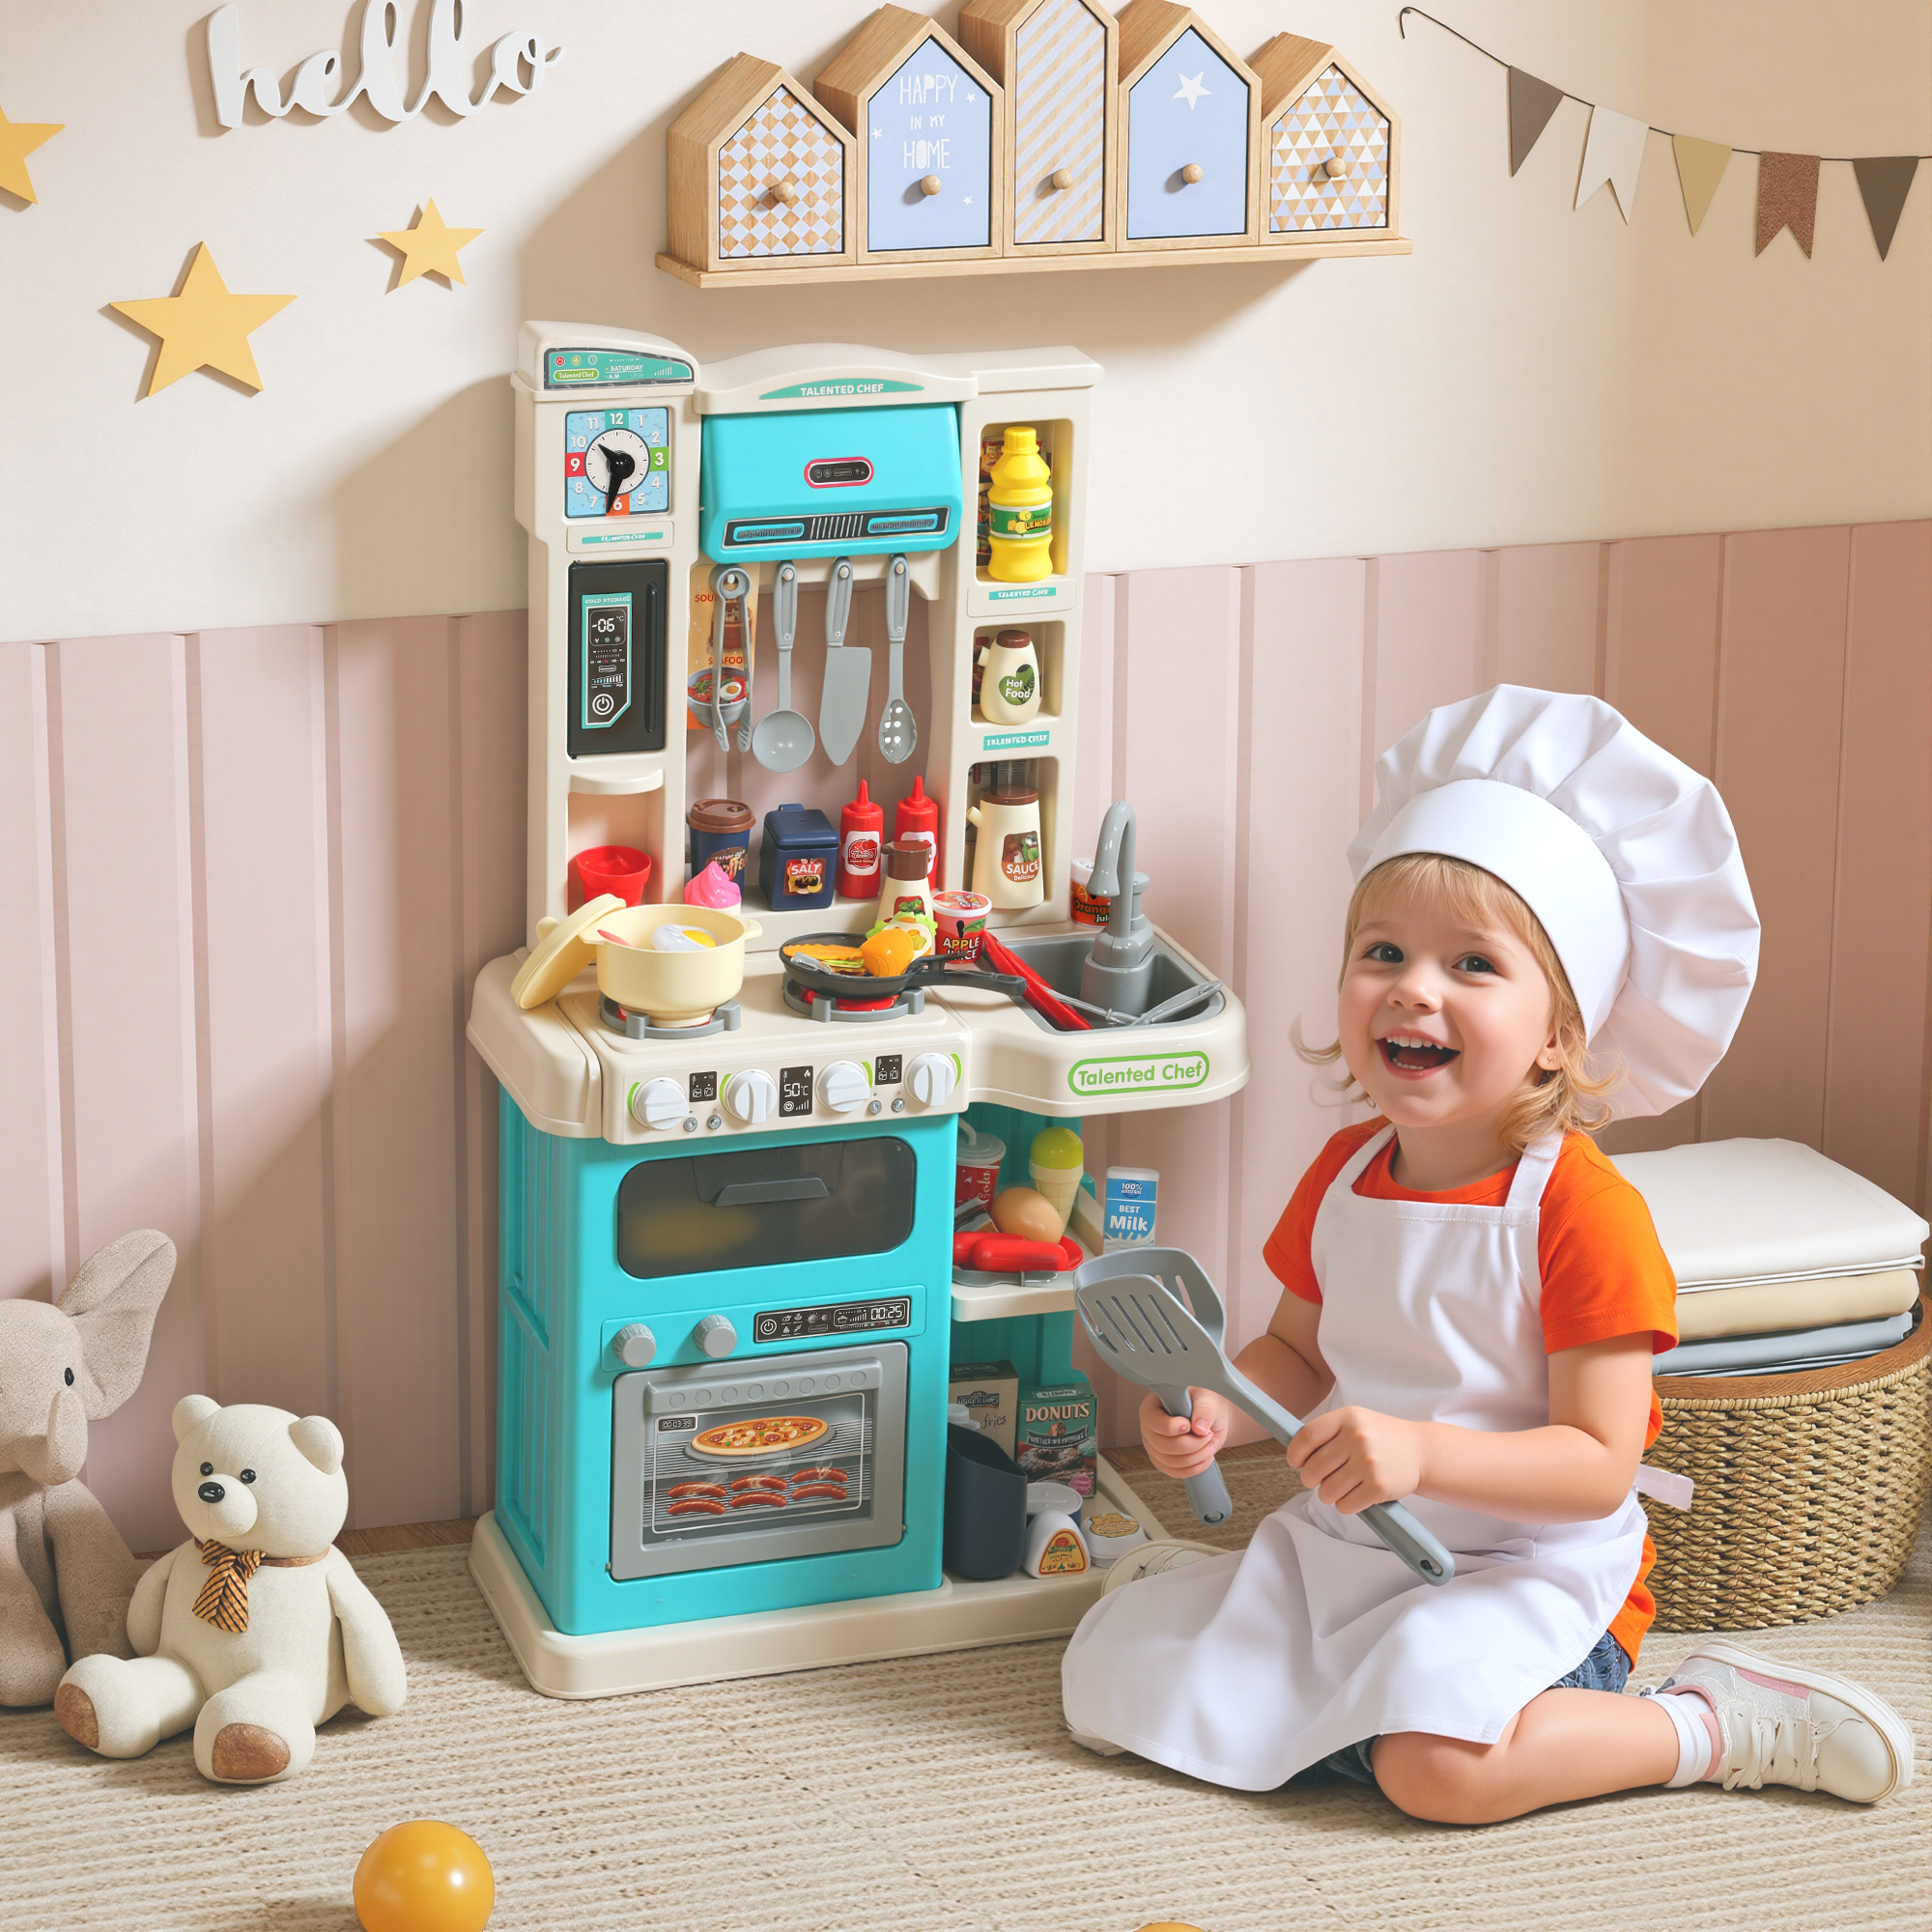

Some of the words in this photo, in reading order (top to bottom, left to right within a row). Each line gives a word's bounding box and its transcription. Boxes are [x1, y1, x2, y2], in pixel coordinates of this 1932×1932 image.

[208, 0, 567, 128] hello
[899, 73, 958, 105] HAPPY
[910, 115, 923, 130] IN
[929, 114, 946, 128] MY
[903, 138, 951, 169] HOME
[800, 384, 855, 397] TALENTED
[857, 384, 884, 393] CHEF
[587, 417, 599, 431] 11
[610, 412, 624, 425] 12
[638, 414, 644, 427] 1
[570, 436, 586, 449] 10
[651, 431, 661, 444] 2
[570, 457, 581, 472] 9
[654, 451, 665, 467] 3
[575, 481, 583, 495] 8
[651, 476, 662, 489] 4
[589, 496, 598, 509] 7
[612, 497, 623, 511] 6
[637, 493, 645, 505] 5
[695, 593, 716, 603] SOU
[708, 656, 743, 666] SFOO
[1006, 678, 1023, 688] Hot
[1005, 688, 1031, 698] Food
[791, 864, 821, 875] SALT
[1006, 860, 1038, 875] SAUCE
[1095, 914, 1110, 923] jui
[943, 936, 980, 950] APPLE
[1078, 1065, 1155, 1086] Talented
[1162, 1061, 1202, 1080] Chef
[1122, 1182, 1142, 1191] 100%
[1119, 1205, 1141, 1213] BEST
[1109, 1215, 1148, 1232] Milk
[870, 1305, 902, 1321] 00:25
[1025, 1402, 1091, 1423] DONUTS
